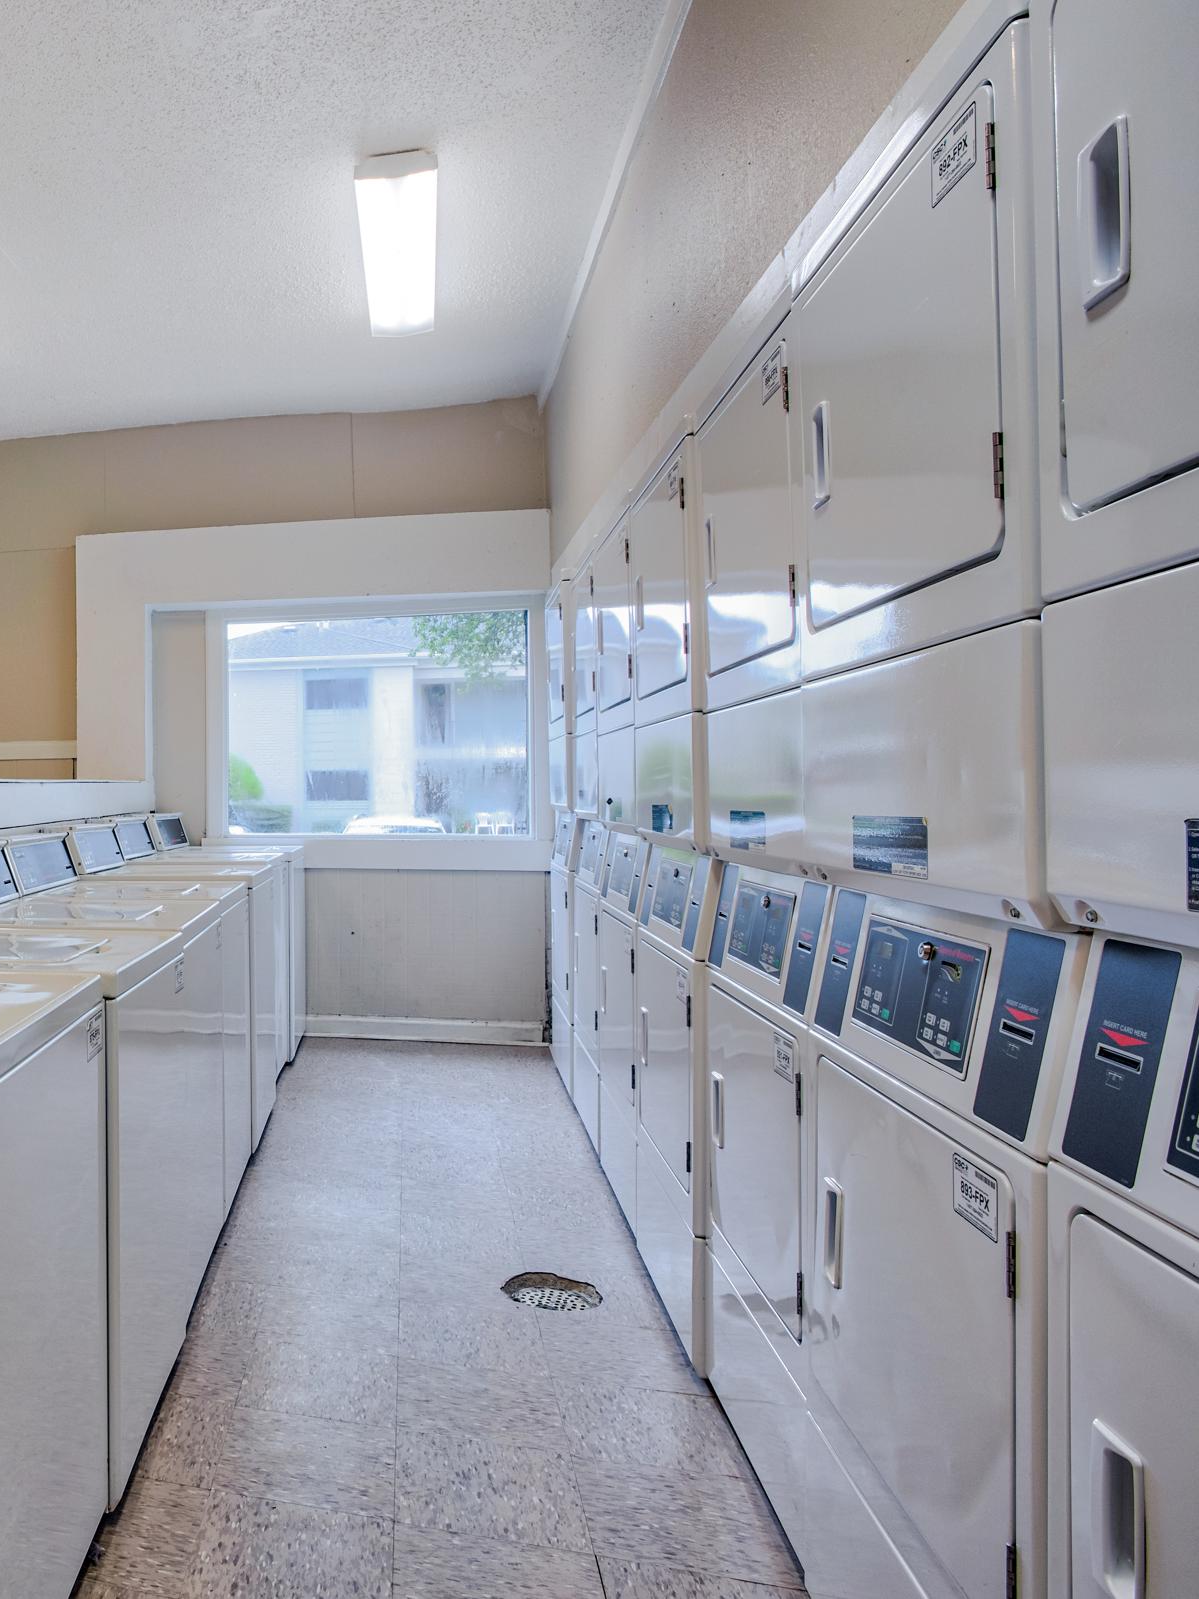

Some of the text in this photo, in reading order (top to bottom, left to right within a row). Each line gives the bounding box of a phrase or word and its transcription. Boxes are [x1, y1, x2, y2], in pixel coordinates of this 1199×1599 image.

[938, 135, 968, 177] 892-FPX
[1103, 1019, 1148, 1039] INSERT CARD HERE
[960, 1180, 990, 1213] 893-FPX
